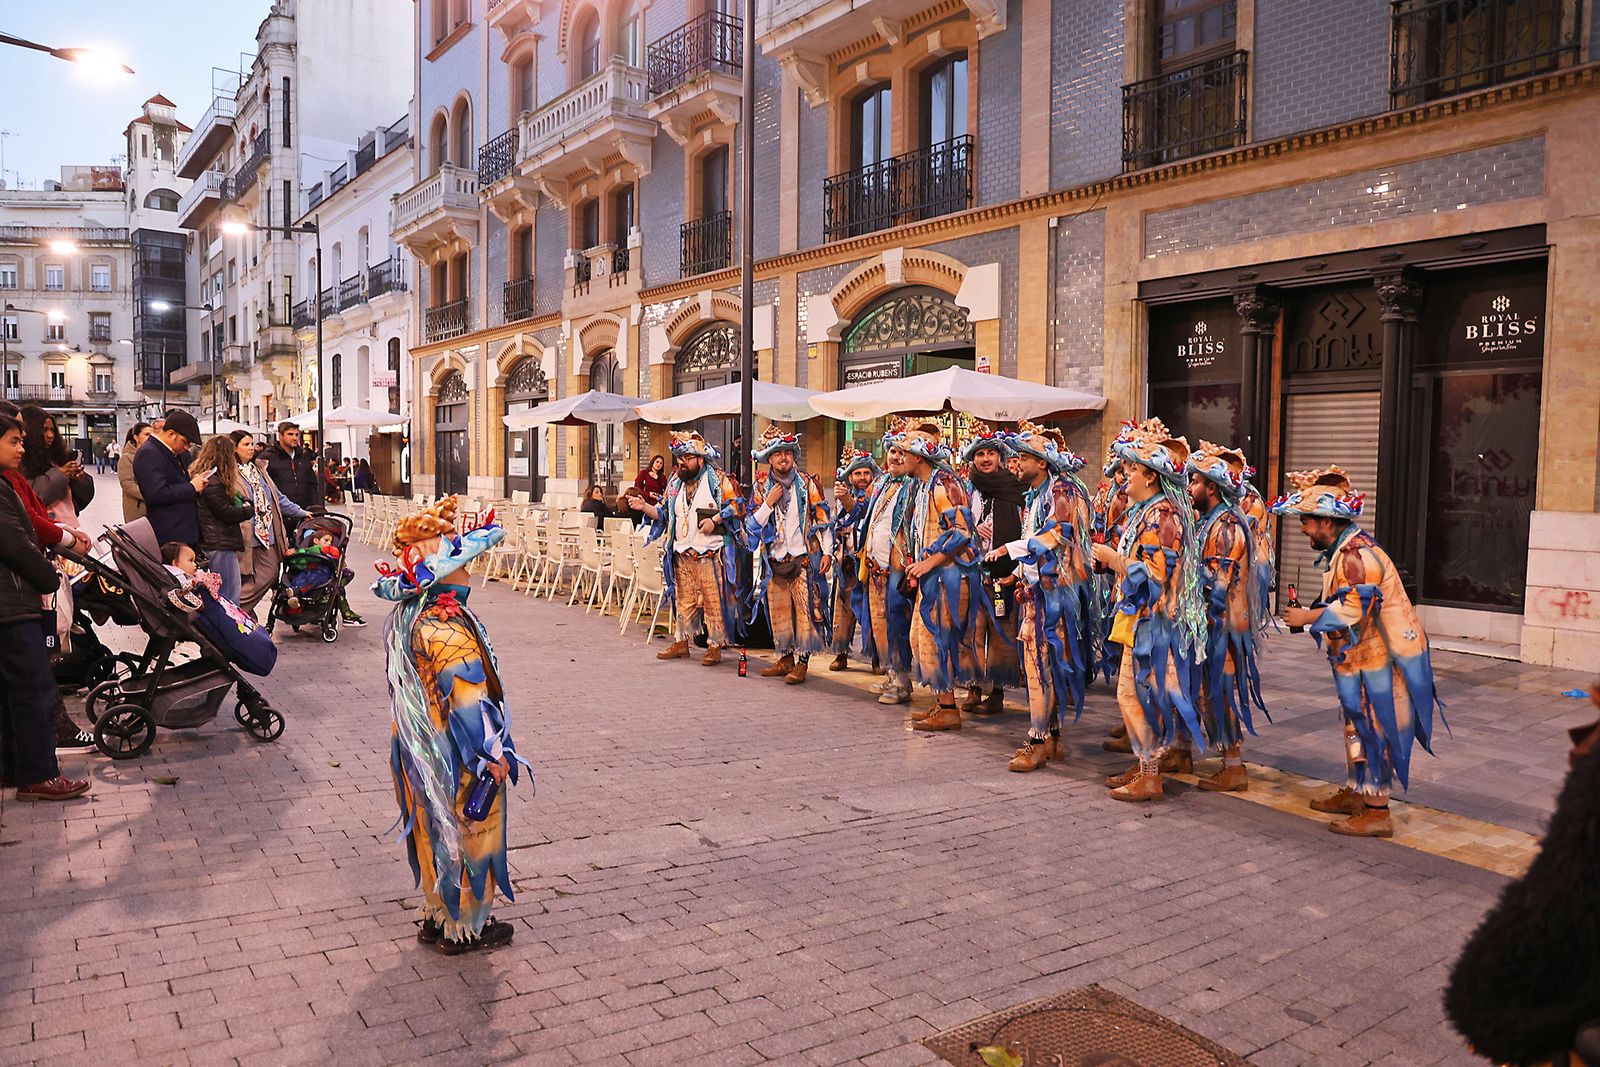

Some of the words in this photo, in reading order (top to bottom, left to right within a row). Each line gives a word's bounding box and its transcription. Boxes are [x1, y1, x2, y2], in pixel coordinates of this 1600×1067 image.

[1481, 312, 1520, 323] ROYAL
[1465, 320, 1536, 340] BLISS
[1187, 335, 1213, 344] ROYAL
[1478, 339, 1522, 347] PREMIUM
[1177, 341, 1225, 357] BLISS
[847, 371, 872, 381] ESPACIO
[873, 368, 898, 379] RUBEN'S
